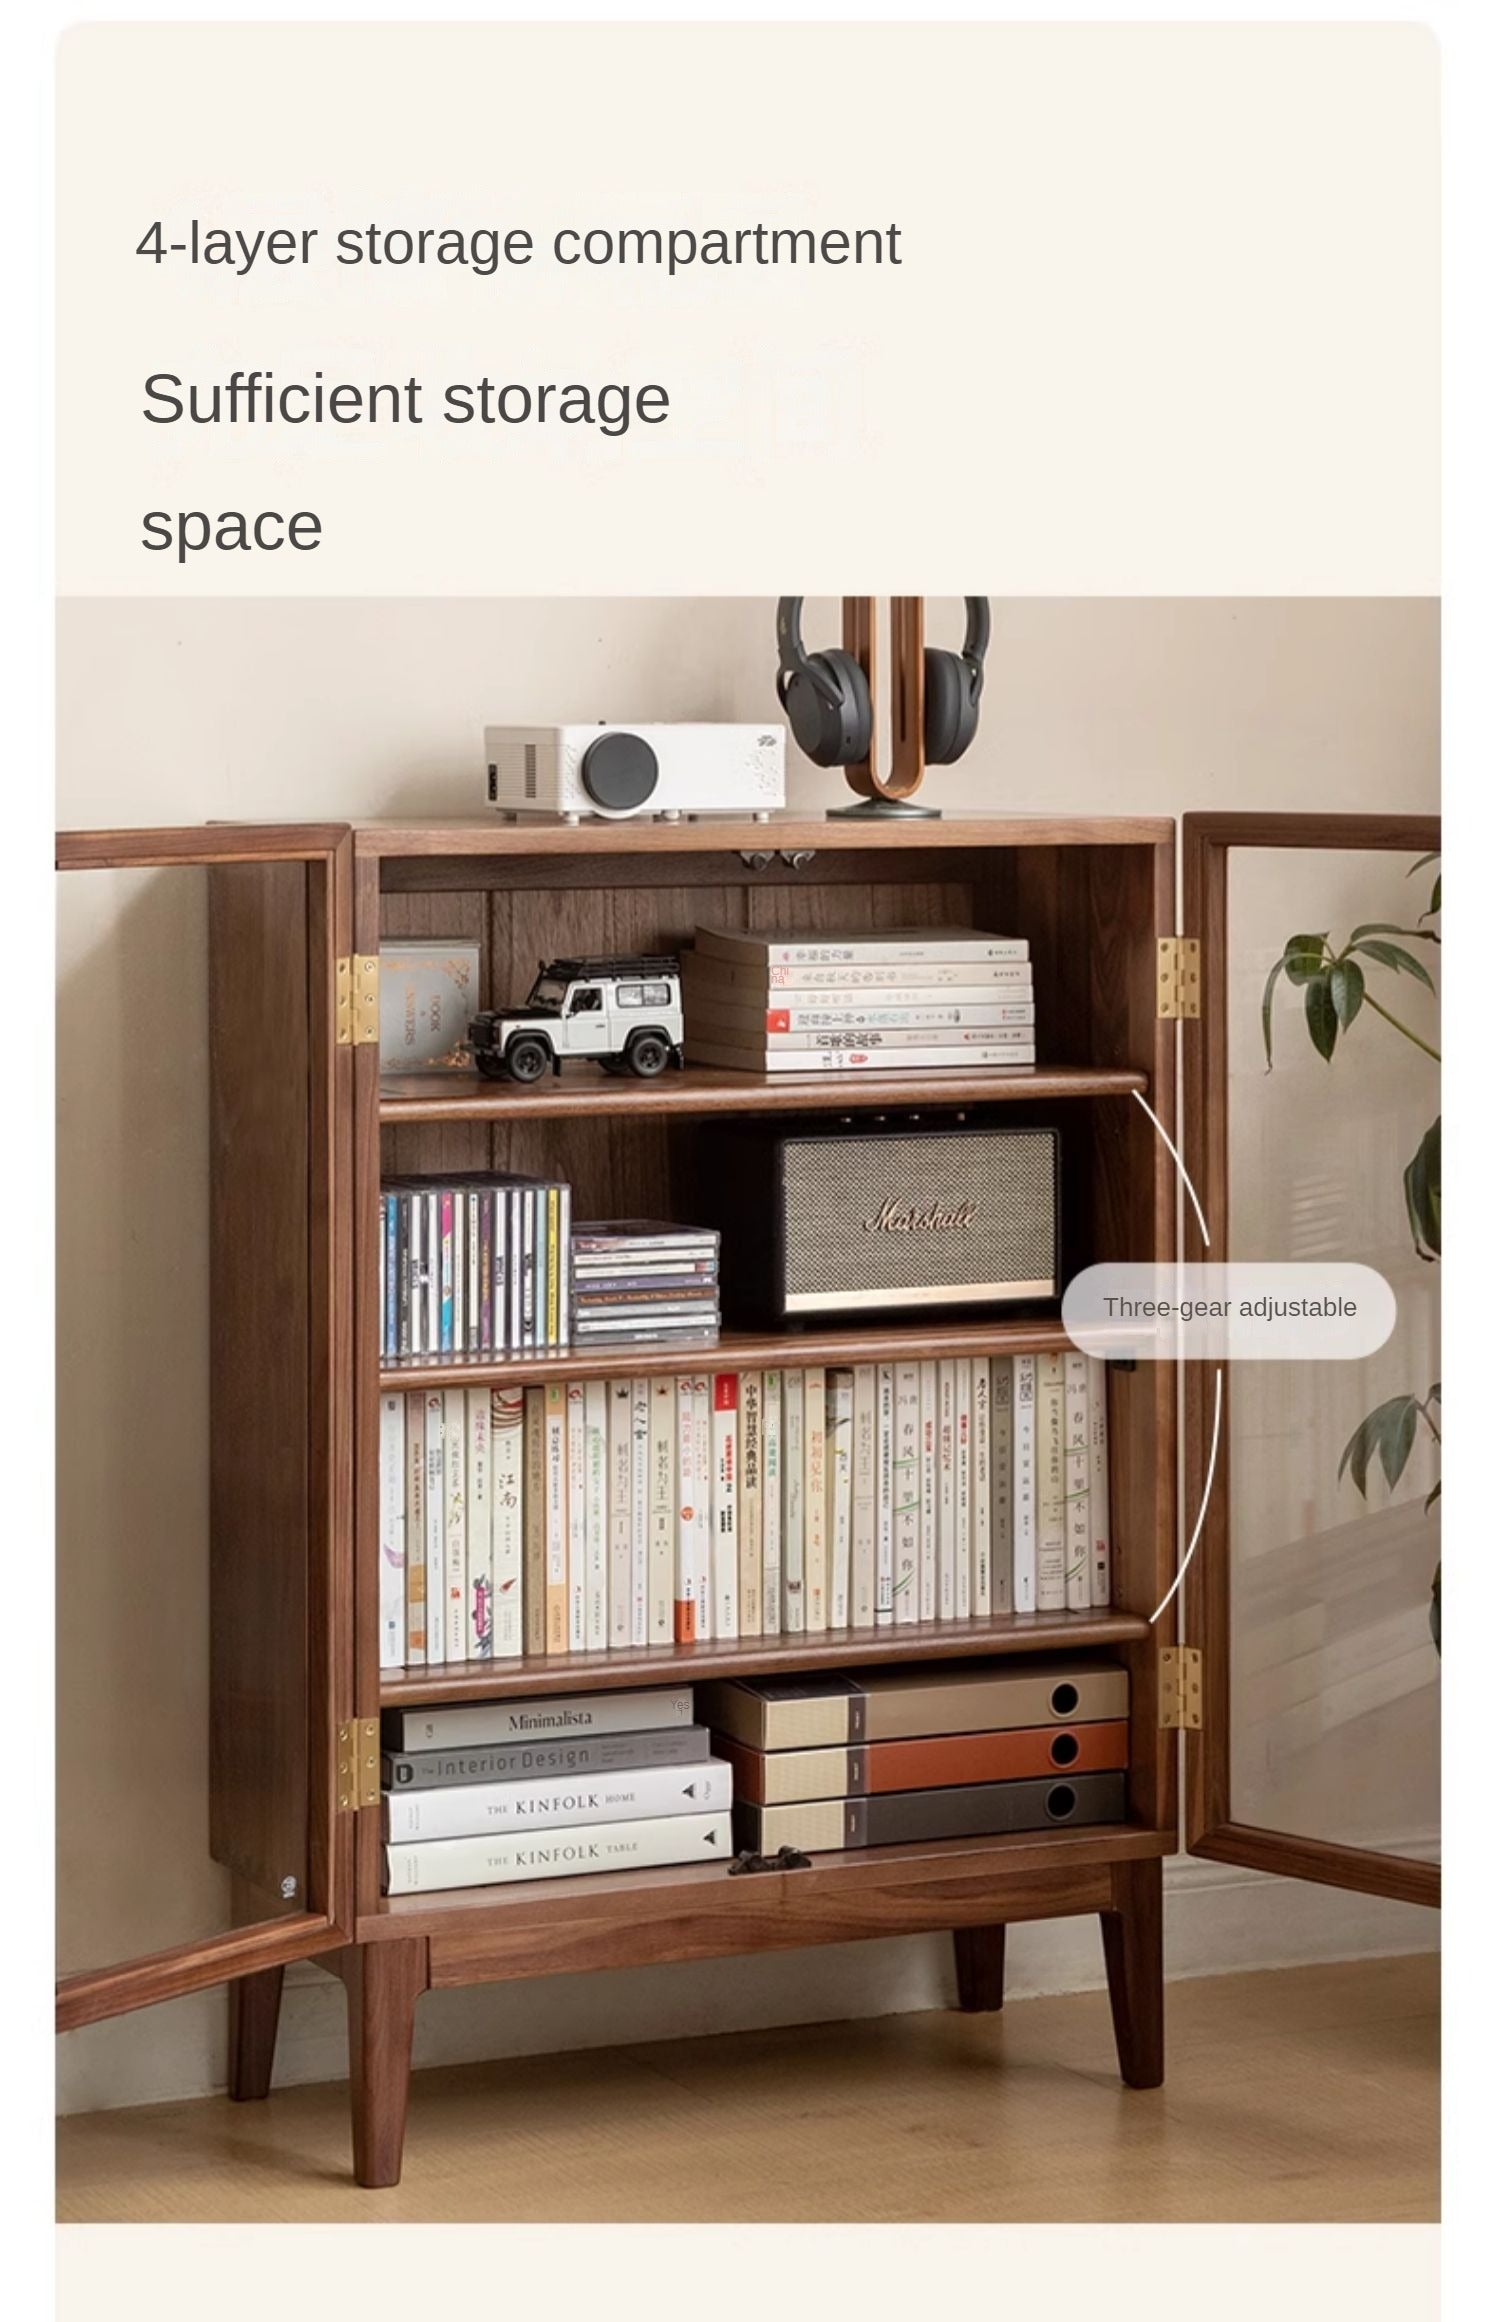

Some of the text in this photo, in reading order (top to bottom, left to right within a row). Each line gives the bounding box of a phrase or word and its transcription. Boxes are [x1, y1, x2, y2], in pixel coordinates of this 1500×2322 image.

[863, 1197, 977, 1232] Marshall
[499, 1473, 519, 1509] 江南
[508, 1710, 593, 1732] Minimalista
[437, 1754, 516, 1776] Interior
[521, 1748, 590, 1769] Design
[487, 1792, 636, 1815] THE KINFOLK HOME
[487, 1842, 638, 1867] THE KINFOLK TABLE
